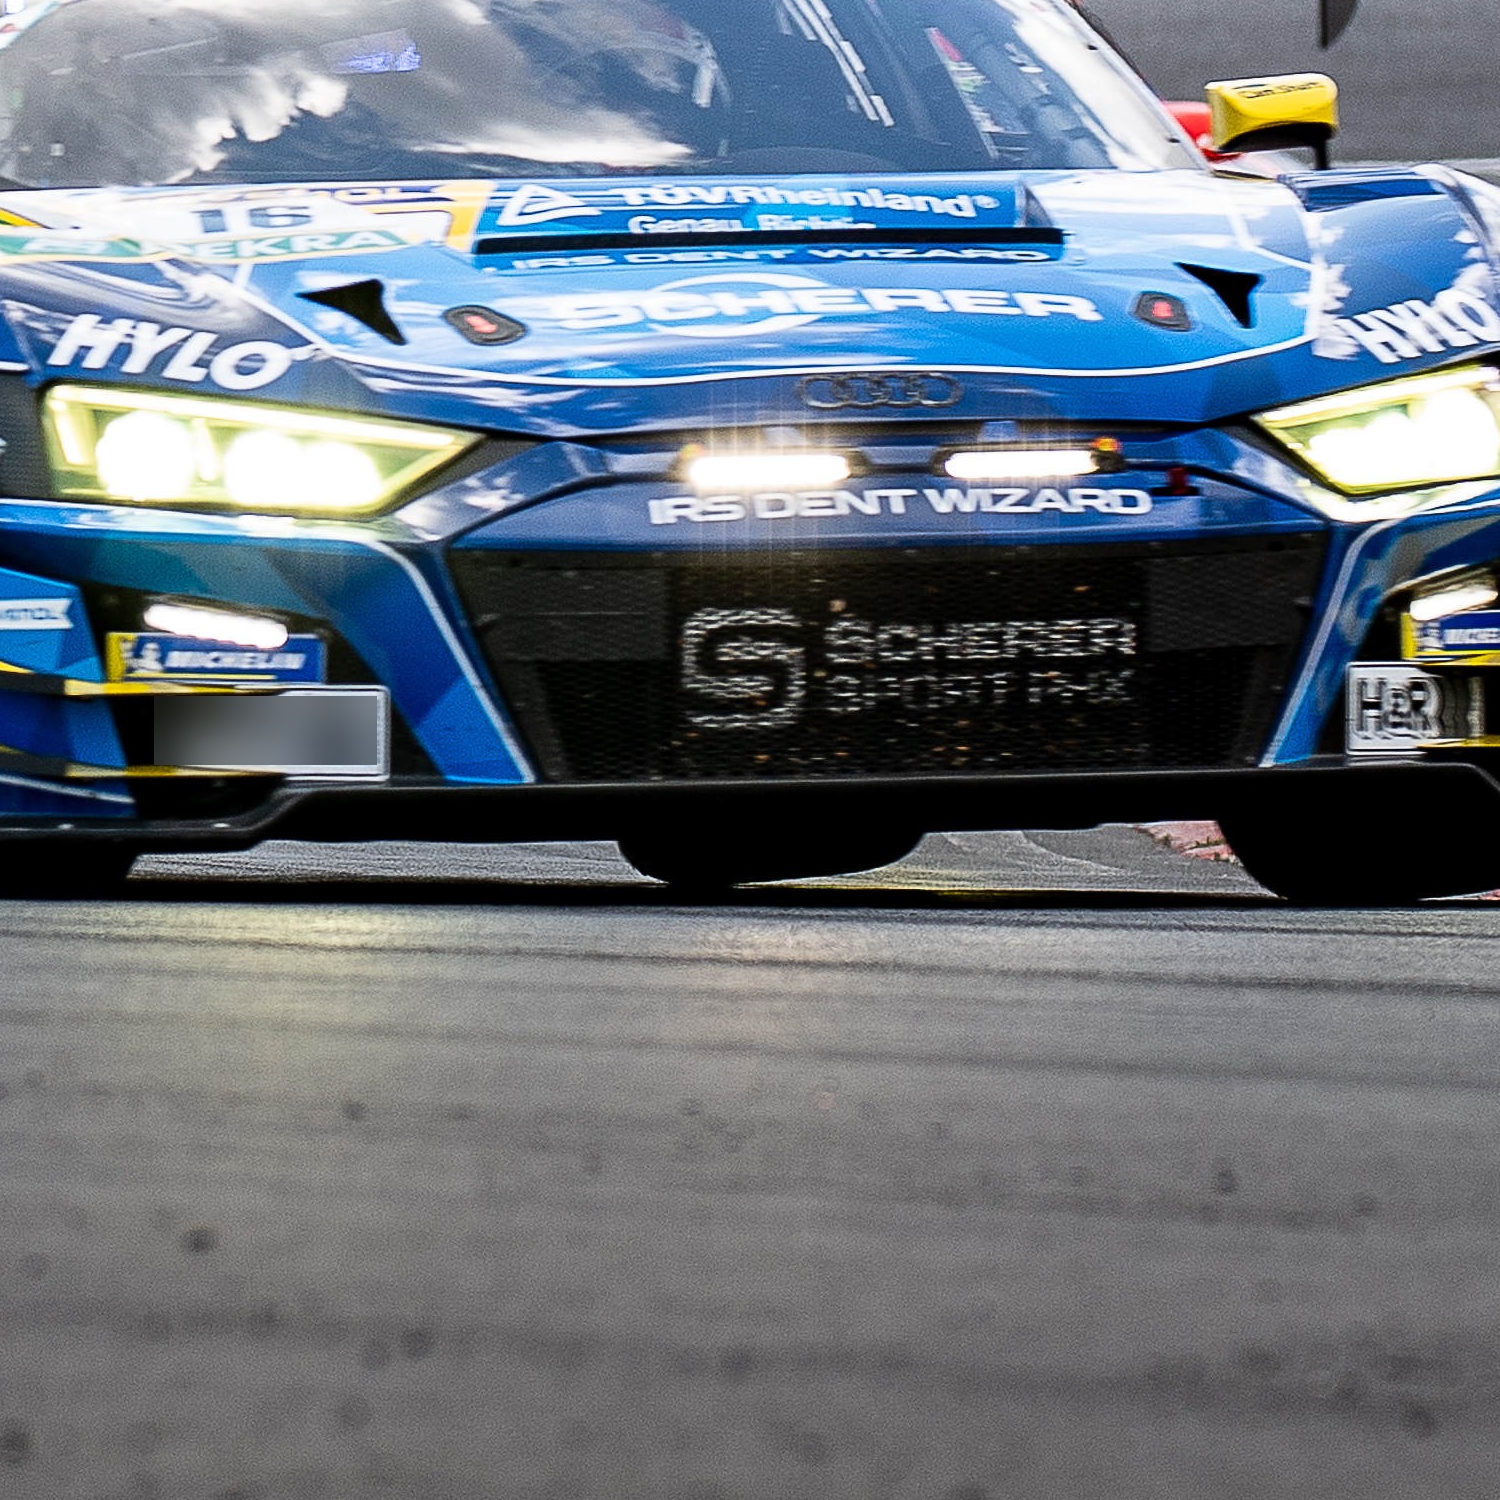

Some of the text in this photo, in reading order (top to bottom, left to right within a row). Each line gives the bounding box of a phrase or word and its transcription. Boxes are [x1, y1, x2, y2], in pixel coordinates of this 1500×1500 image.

[191, 206, 313, 233] 16
[513, 246, 1052, 271] IRS DENT WIZARD
[550, 288, 1104, 330] SCHERER
[46, 313, 293, 390] HYLO
[648, 487, 1154, 525] IRS DENT WIZARD
